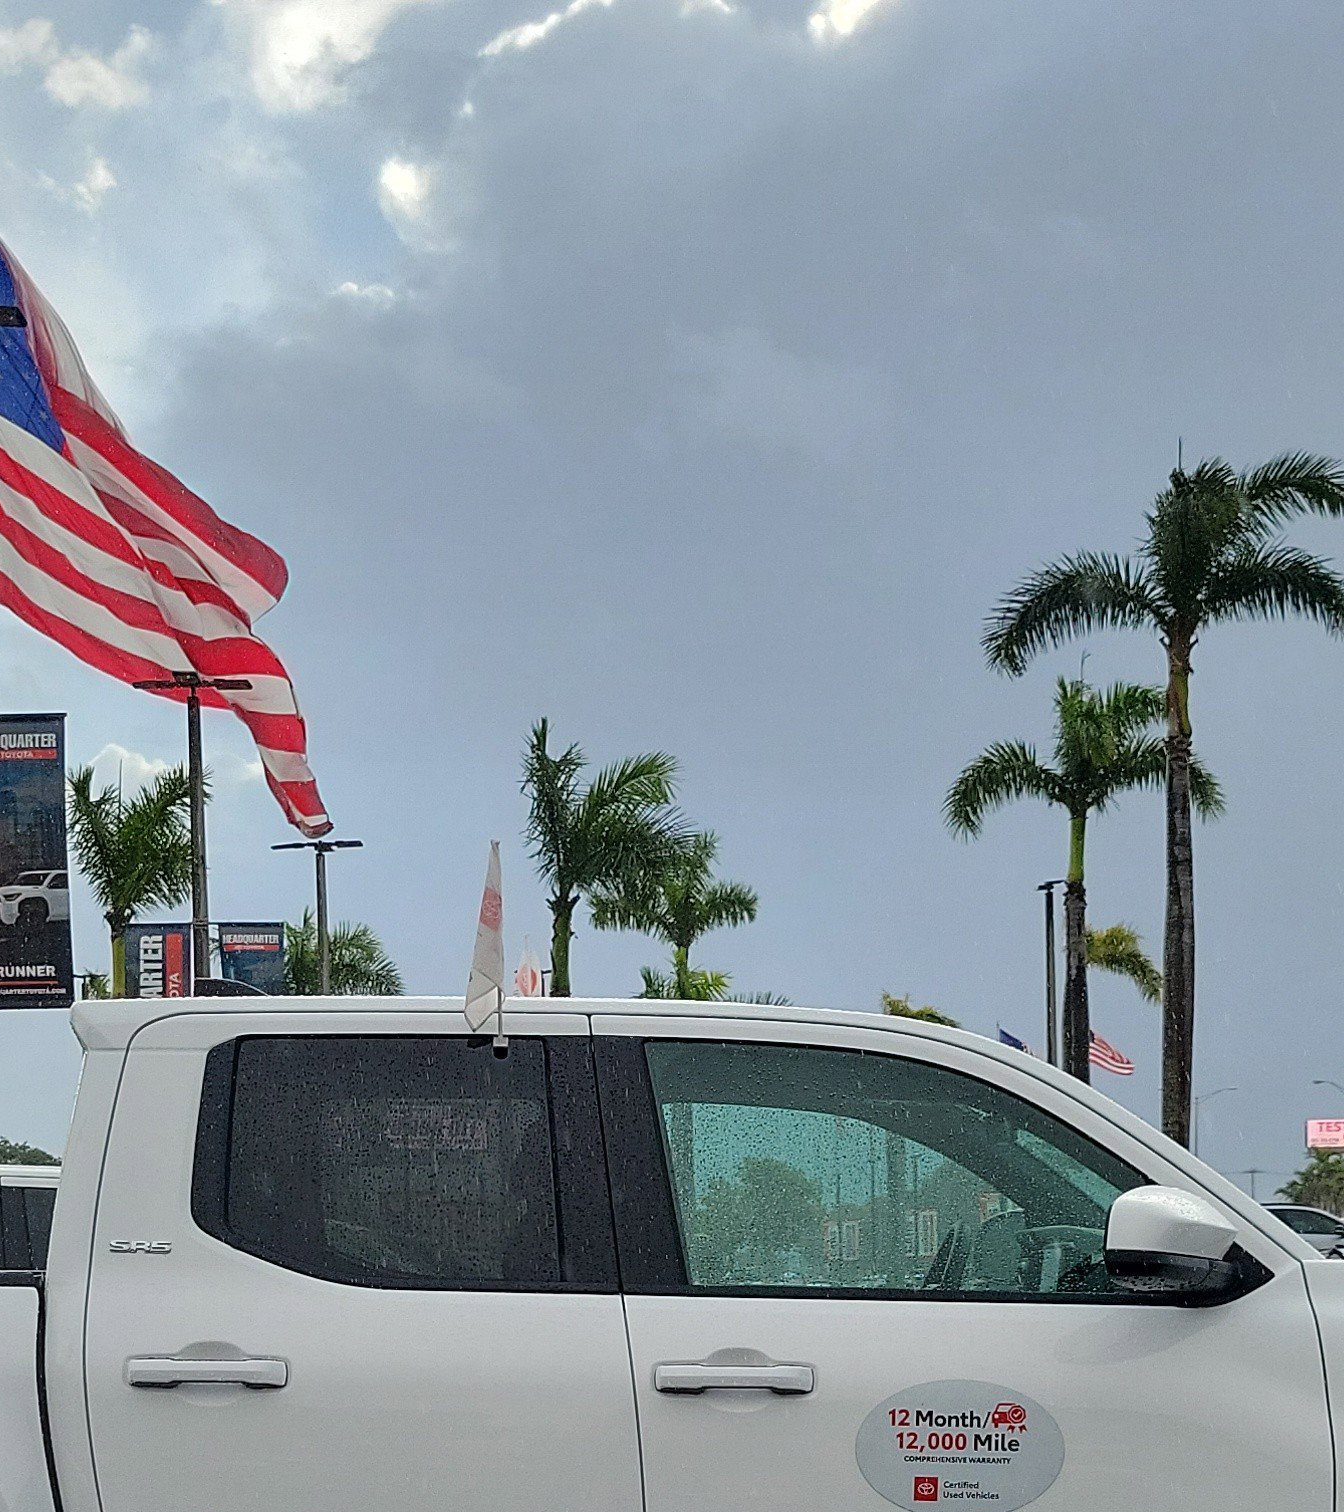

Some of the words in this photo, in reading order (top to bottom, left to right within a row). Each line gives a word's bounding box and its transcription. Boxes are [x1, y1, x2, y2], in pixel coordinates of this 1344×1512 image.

[0, 750, 34, 759] TOYOTA
[222, 934, 280, 945] HEADQUARTER
[139, 934, 163, 998] ARTER
[888, 1408, 910, 1426] 12
[915, 1410, 991, 1428] Month/
[896, 1432, 967, 1452] 12,000
[973, 1433, 1020, 1451] Mile
[903, 1455, 967, 1463] COMPREHENSIVE
[943, 1481, 979, 1489] Certified
[943, 1491, 964, 1499] Used
[965, 1491, 1000, 1500] Vehicles
